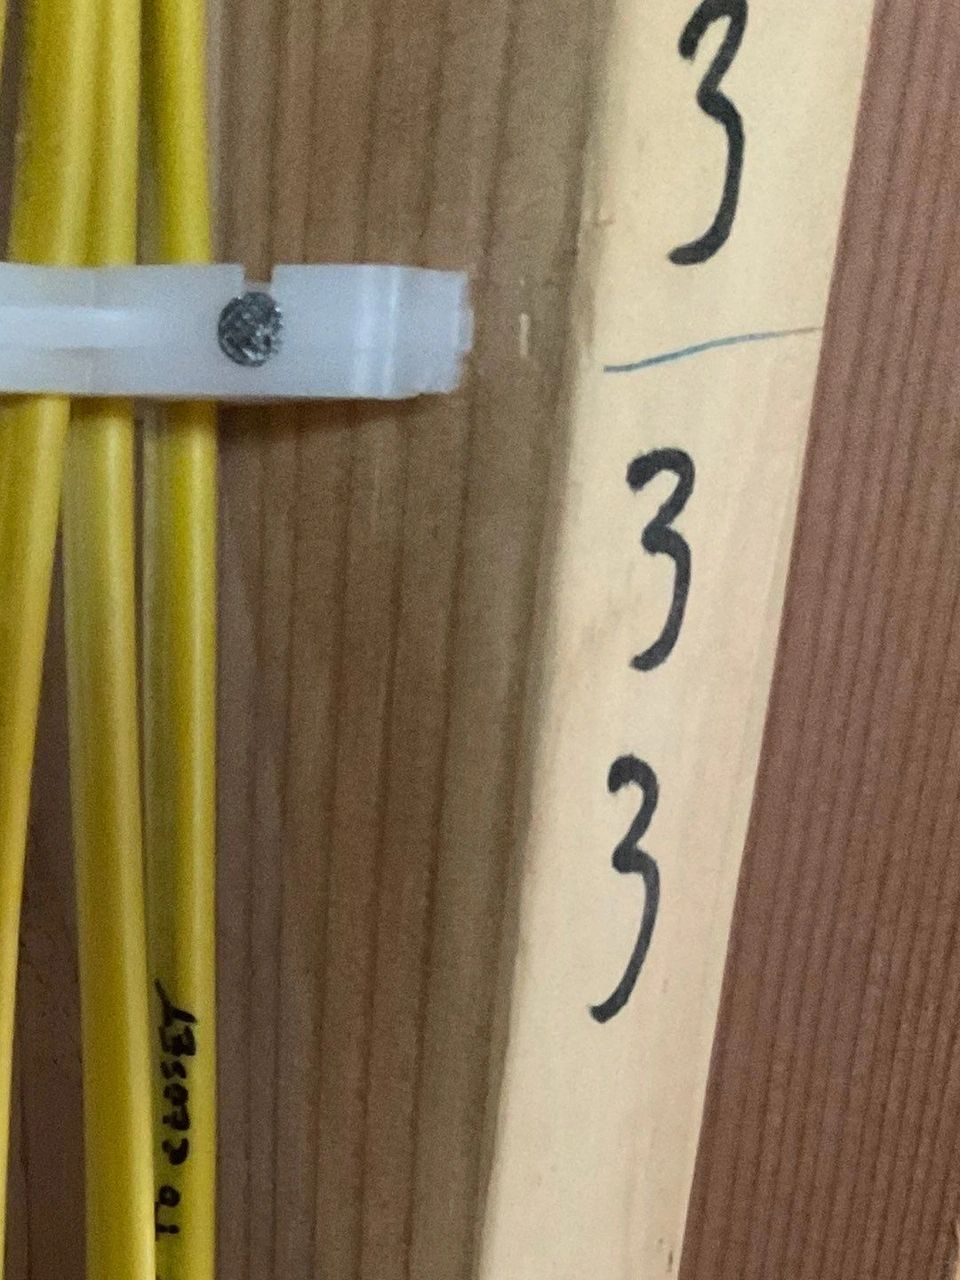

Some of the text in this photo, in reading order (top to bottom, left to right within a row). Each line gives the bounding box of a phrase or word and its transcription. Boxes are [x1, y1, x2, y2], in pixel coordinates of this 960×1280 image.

[667, 0, 748, 266] 3
[626, 447, 696, 673] 3
[589, 754, 661, 1024] 3
[154, 978, 197, 1166] CLOSET
